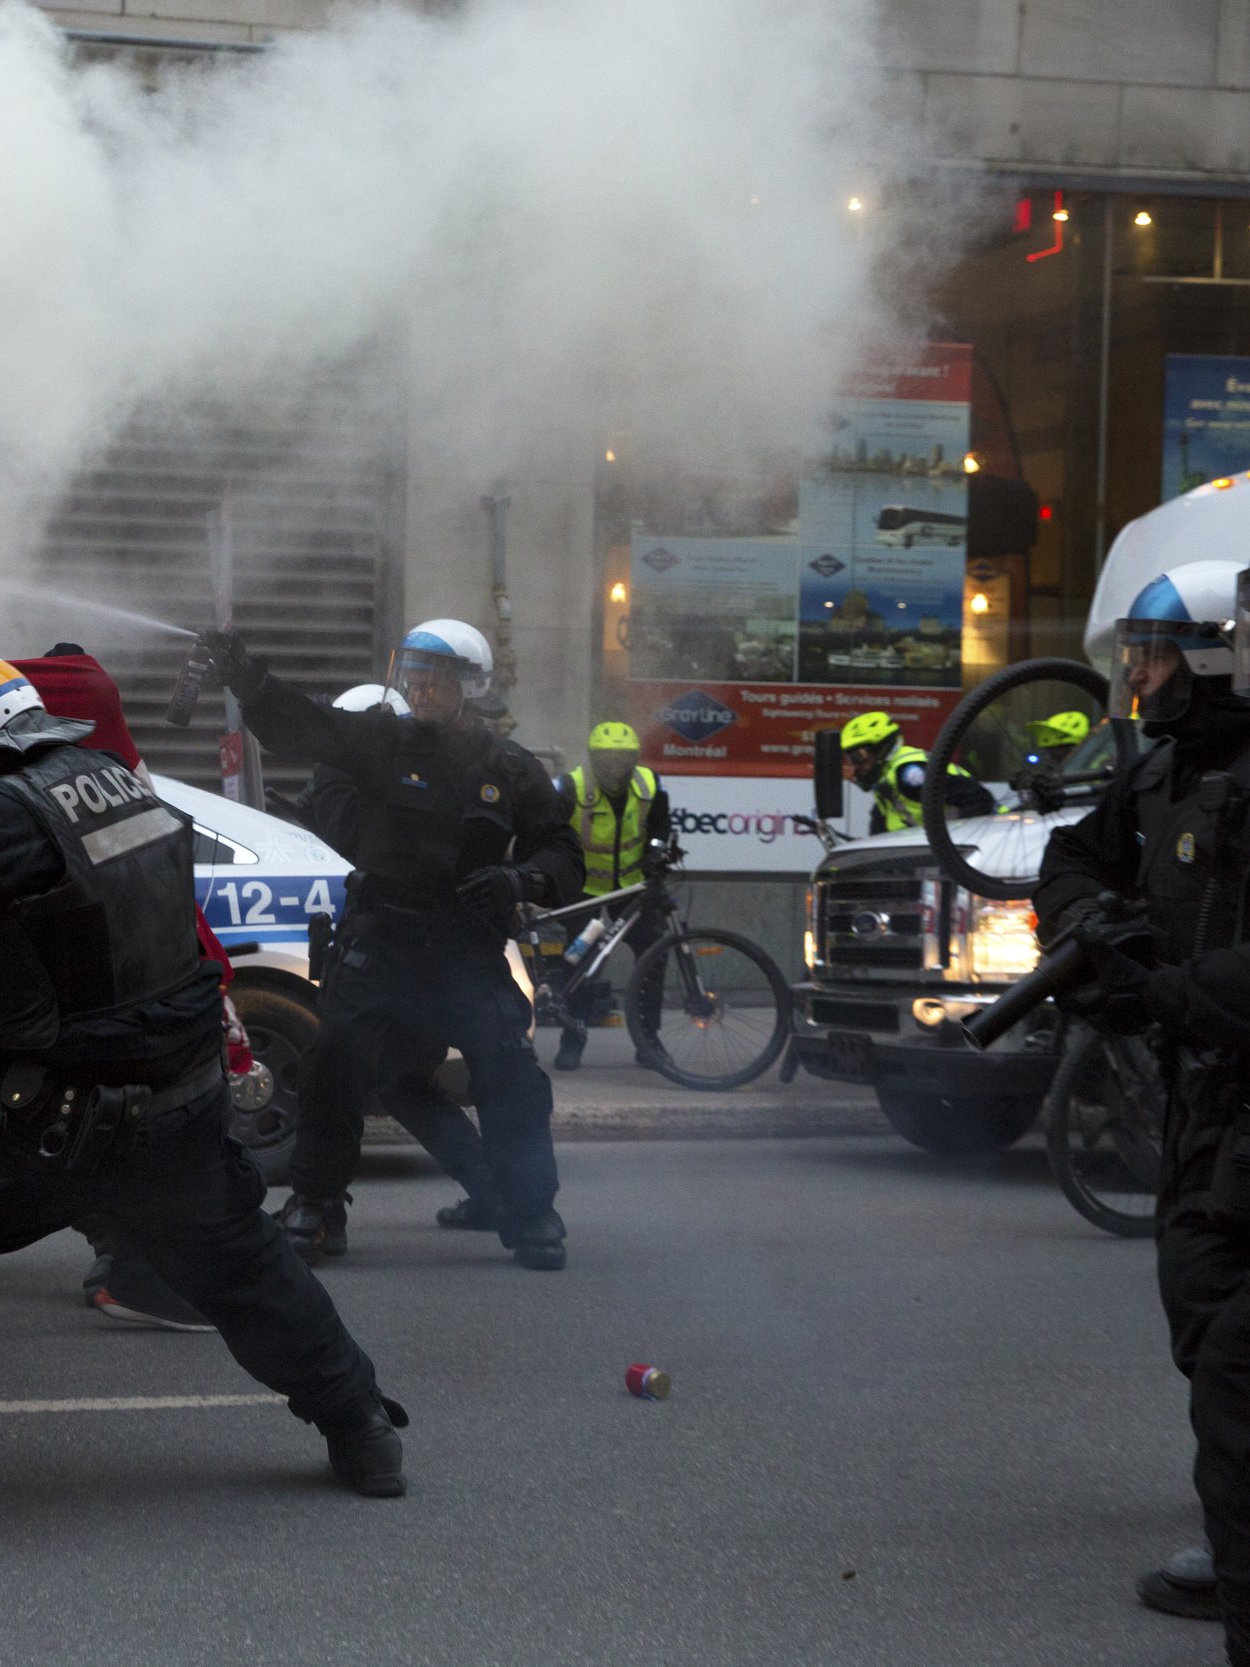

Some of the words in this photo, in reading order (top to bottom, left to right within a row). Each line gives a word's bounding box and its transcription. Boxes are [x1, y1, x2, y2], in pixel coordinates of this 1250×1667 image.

[740, 690, 776, 703] Tours
[835, 693, 890, 706] Services
[663, 743, 727, 758] Montréal
[217, 880, 336, 925] 12-4
